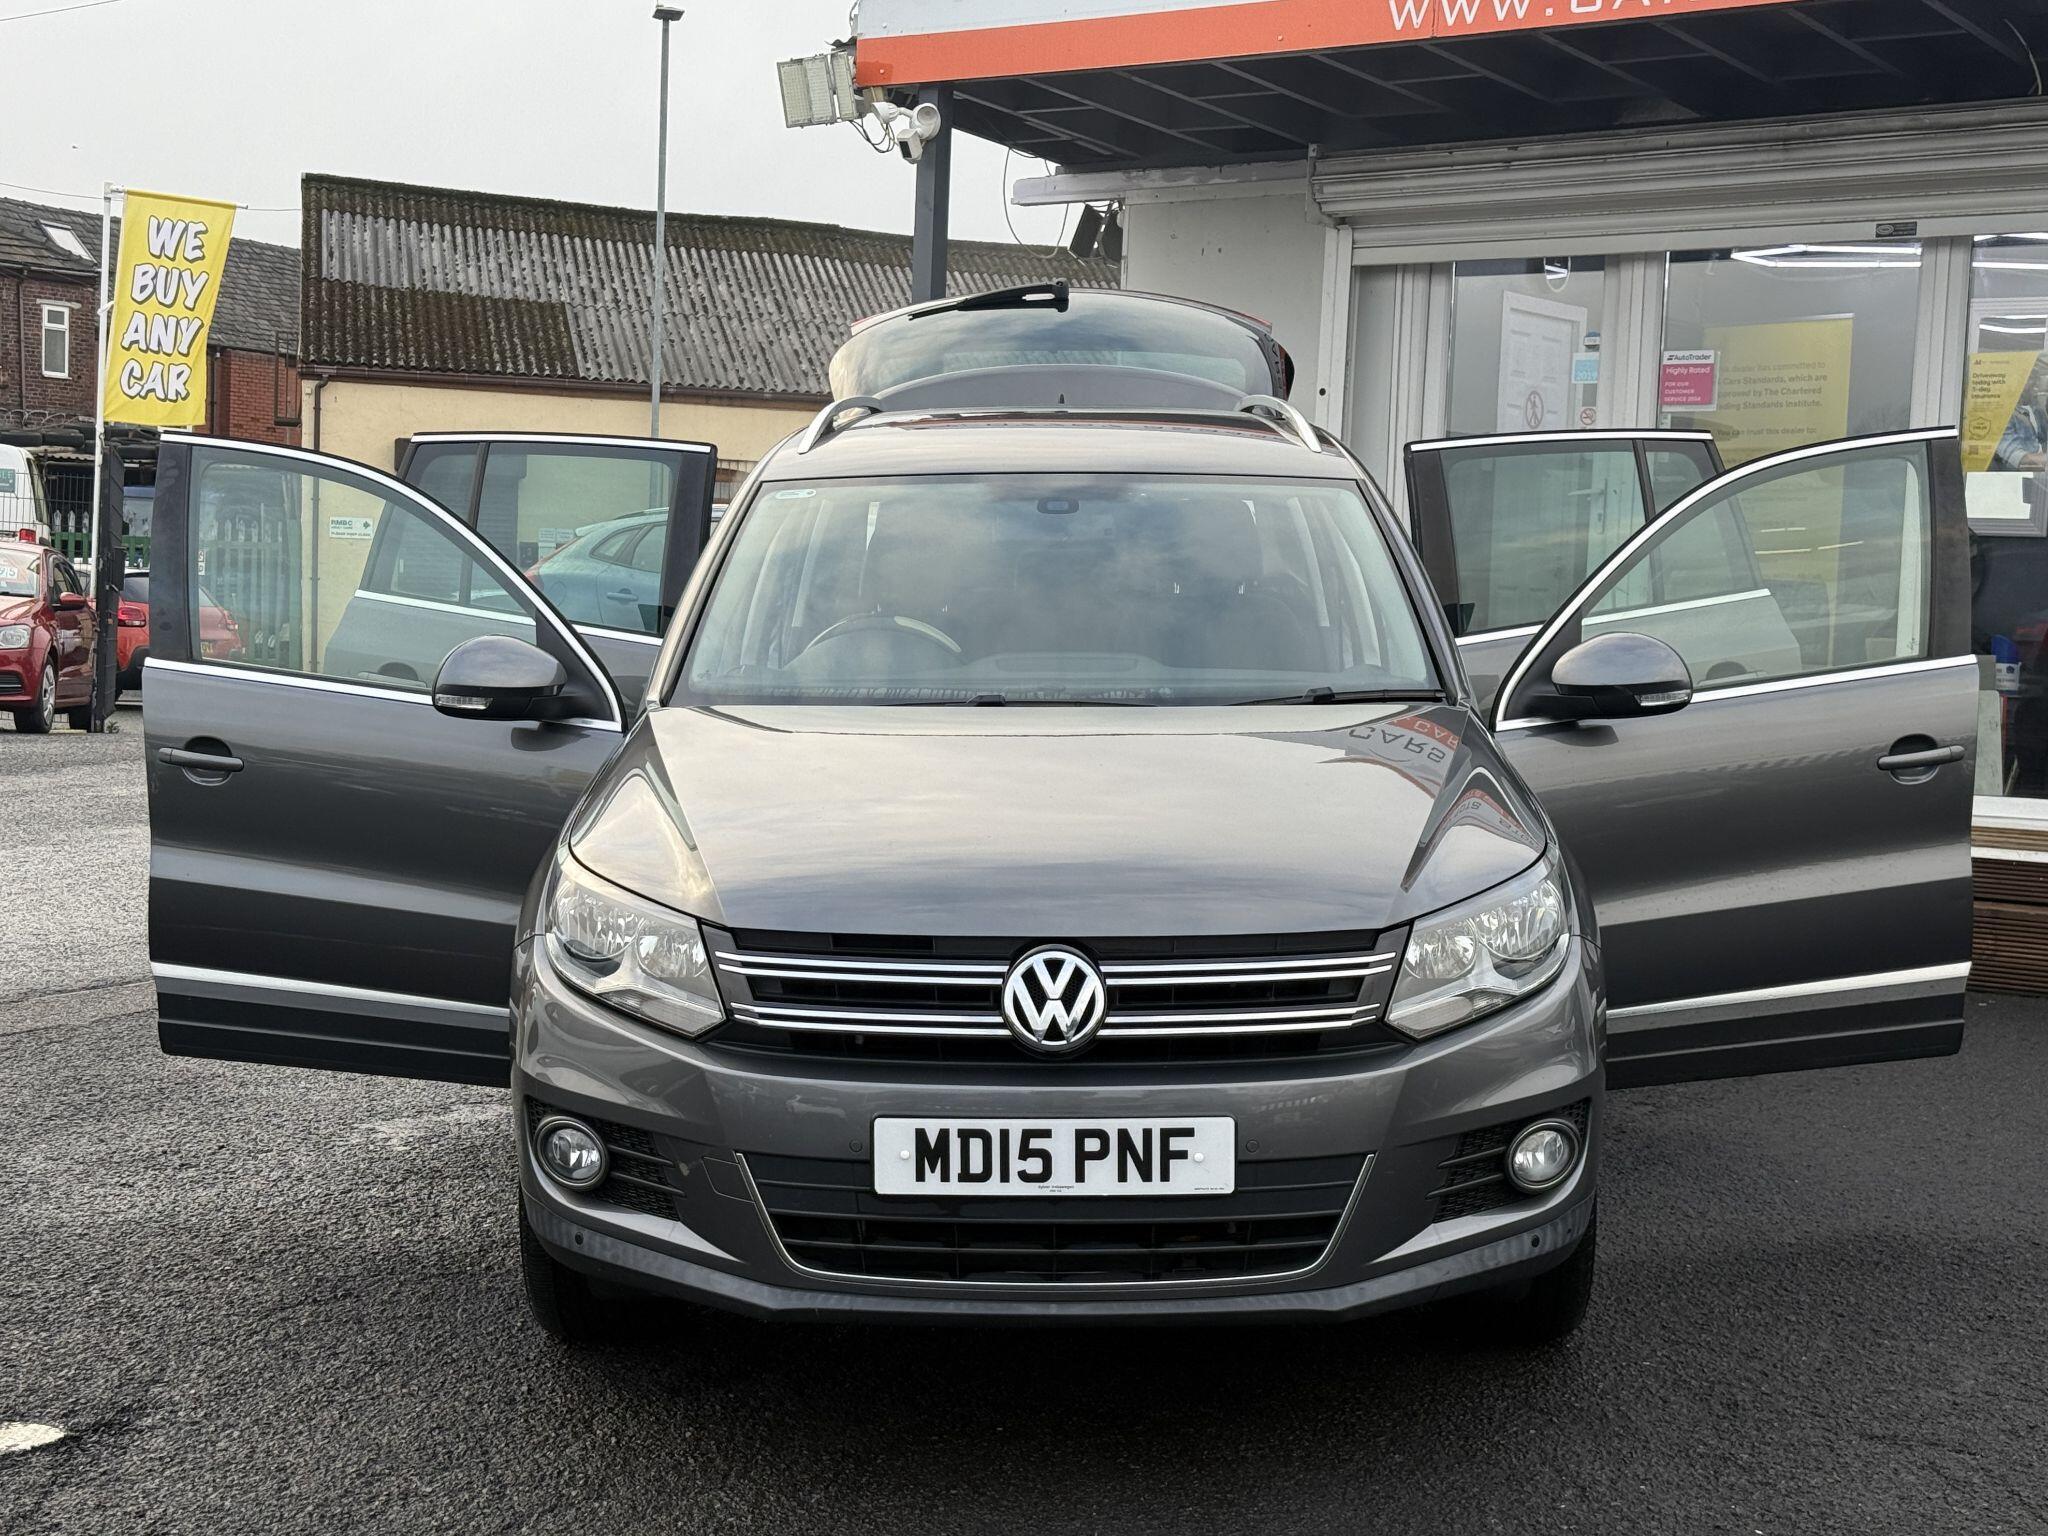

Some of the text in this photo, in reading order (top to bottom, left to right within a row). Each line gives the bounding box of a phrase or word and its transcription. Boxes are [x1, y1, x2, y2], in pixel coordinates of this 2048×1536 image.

[148, 215, 208, 263] WE
[131, 263, 209, 311] BUY
[121, 311, 204, 357] ANY
[120, 358, 192, 402] CAR
[1666, 367, 1688, 375] Highly
[1780, 385, 1822, 395] Chartered
[1788, 373, 1813, 382] which
[915, 1127, 1195, 1183] MD15 PNF
